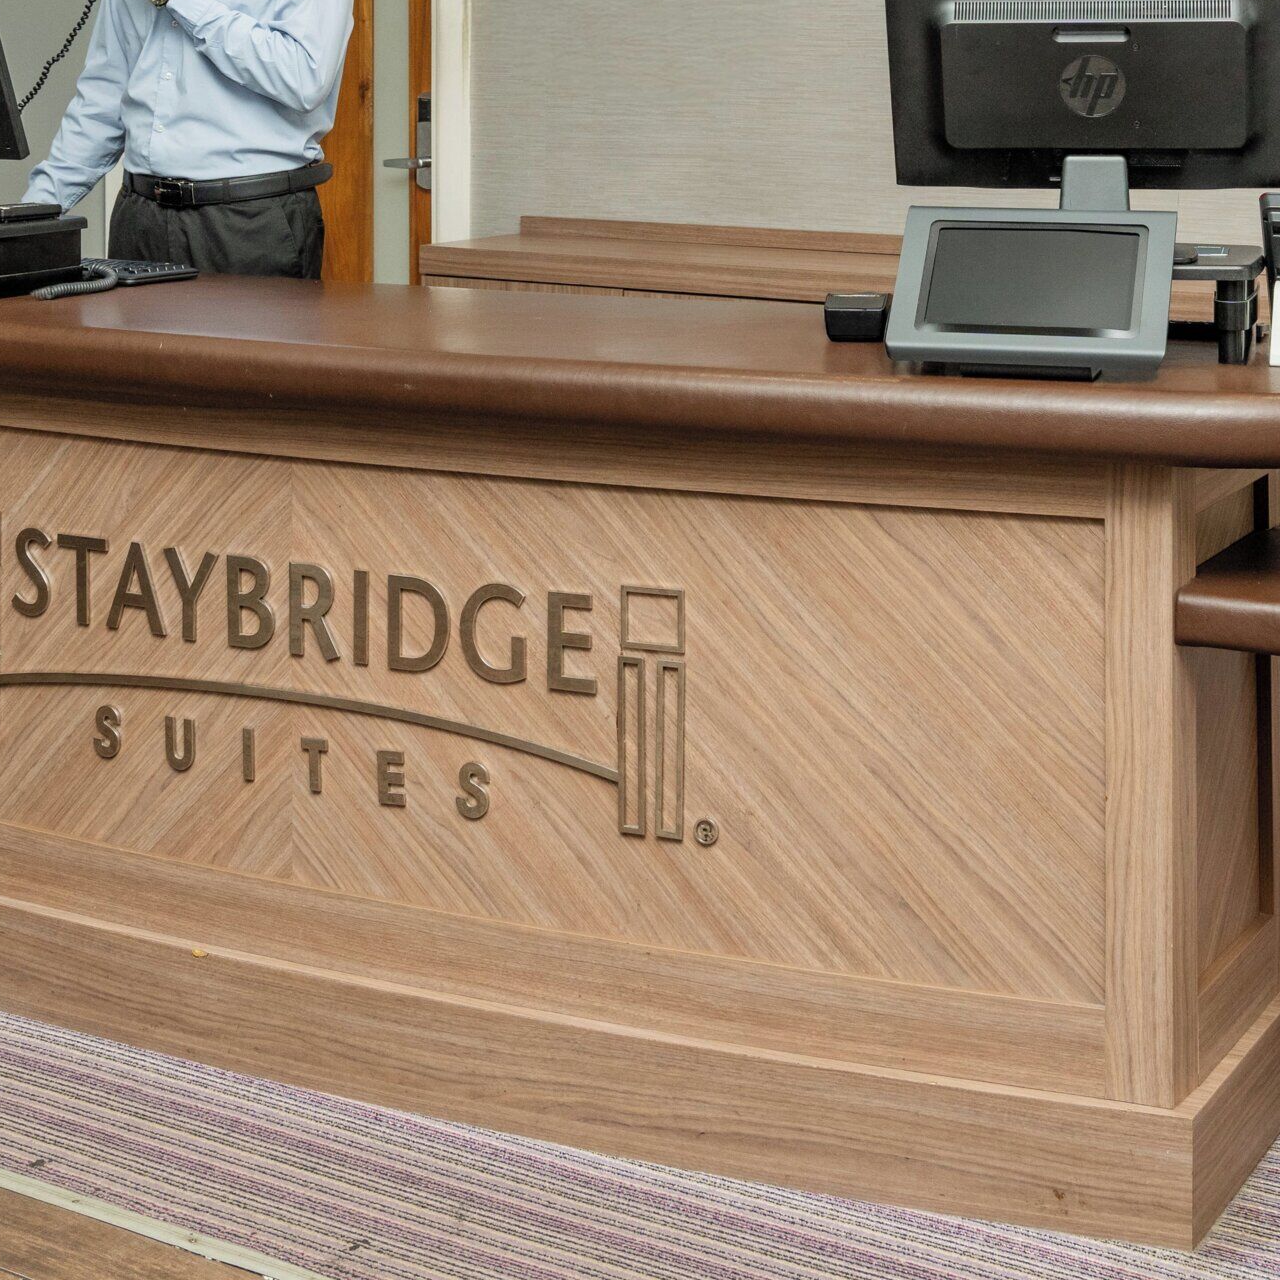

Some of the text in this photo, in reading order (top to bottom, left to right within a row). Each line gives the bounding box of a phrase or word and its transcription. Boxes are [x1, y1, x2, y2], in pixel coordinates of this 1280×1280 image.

[1063, 56, 1119, 116] hp
[11, 526, 598, 695] STAYBRIDGE
[92, 704, 491, 820] SUITES
